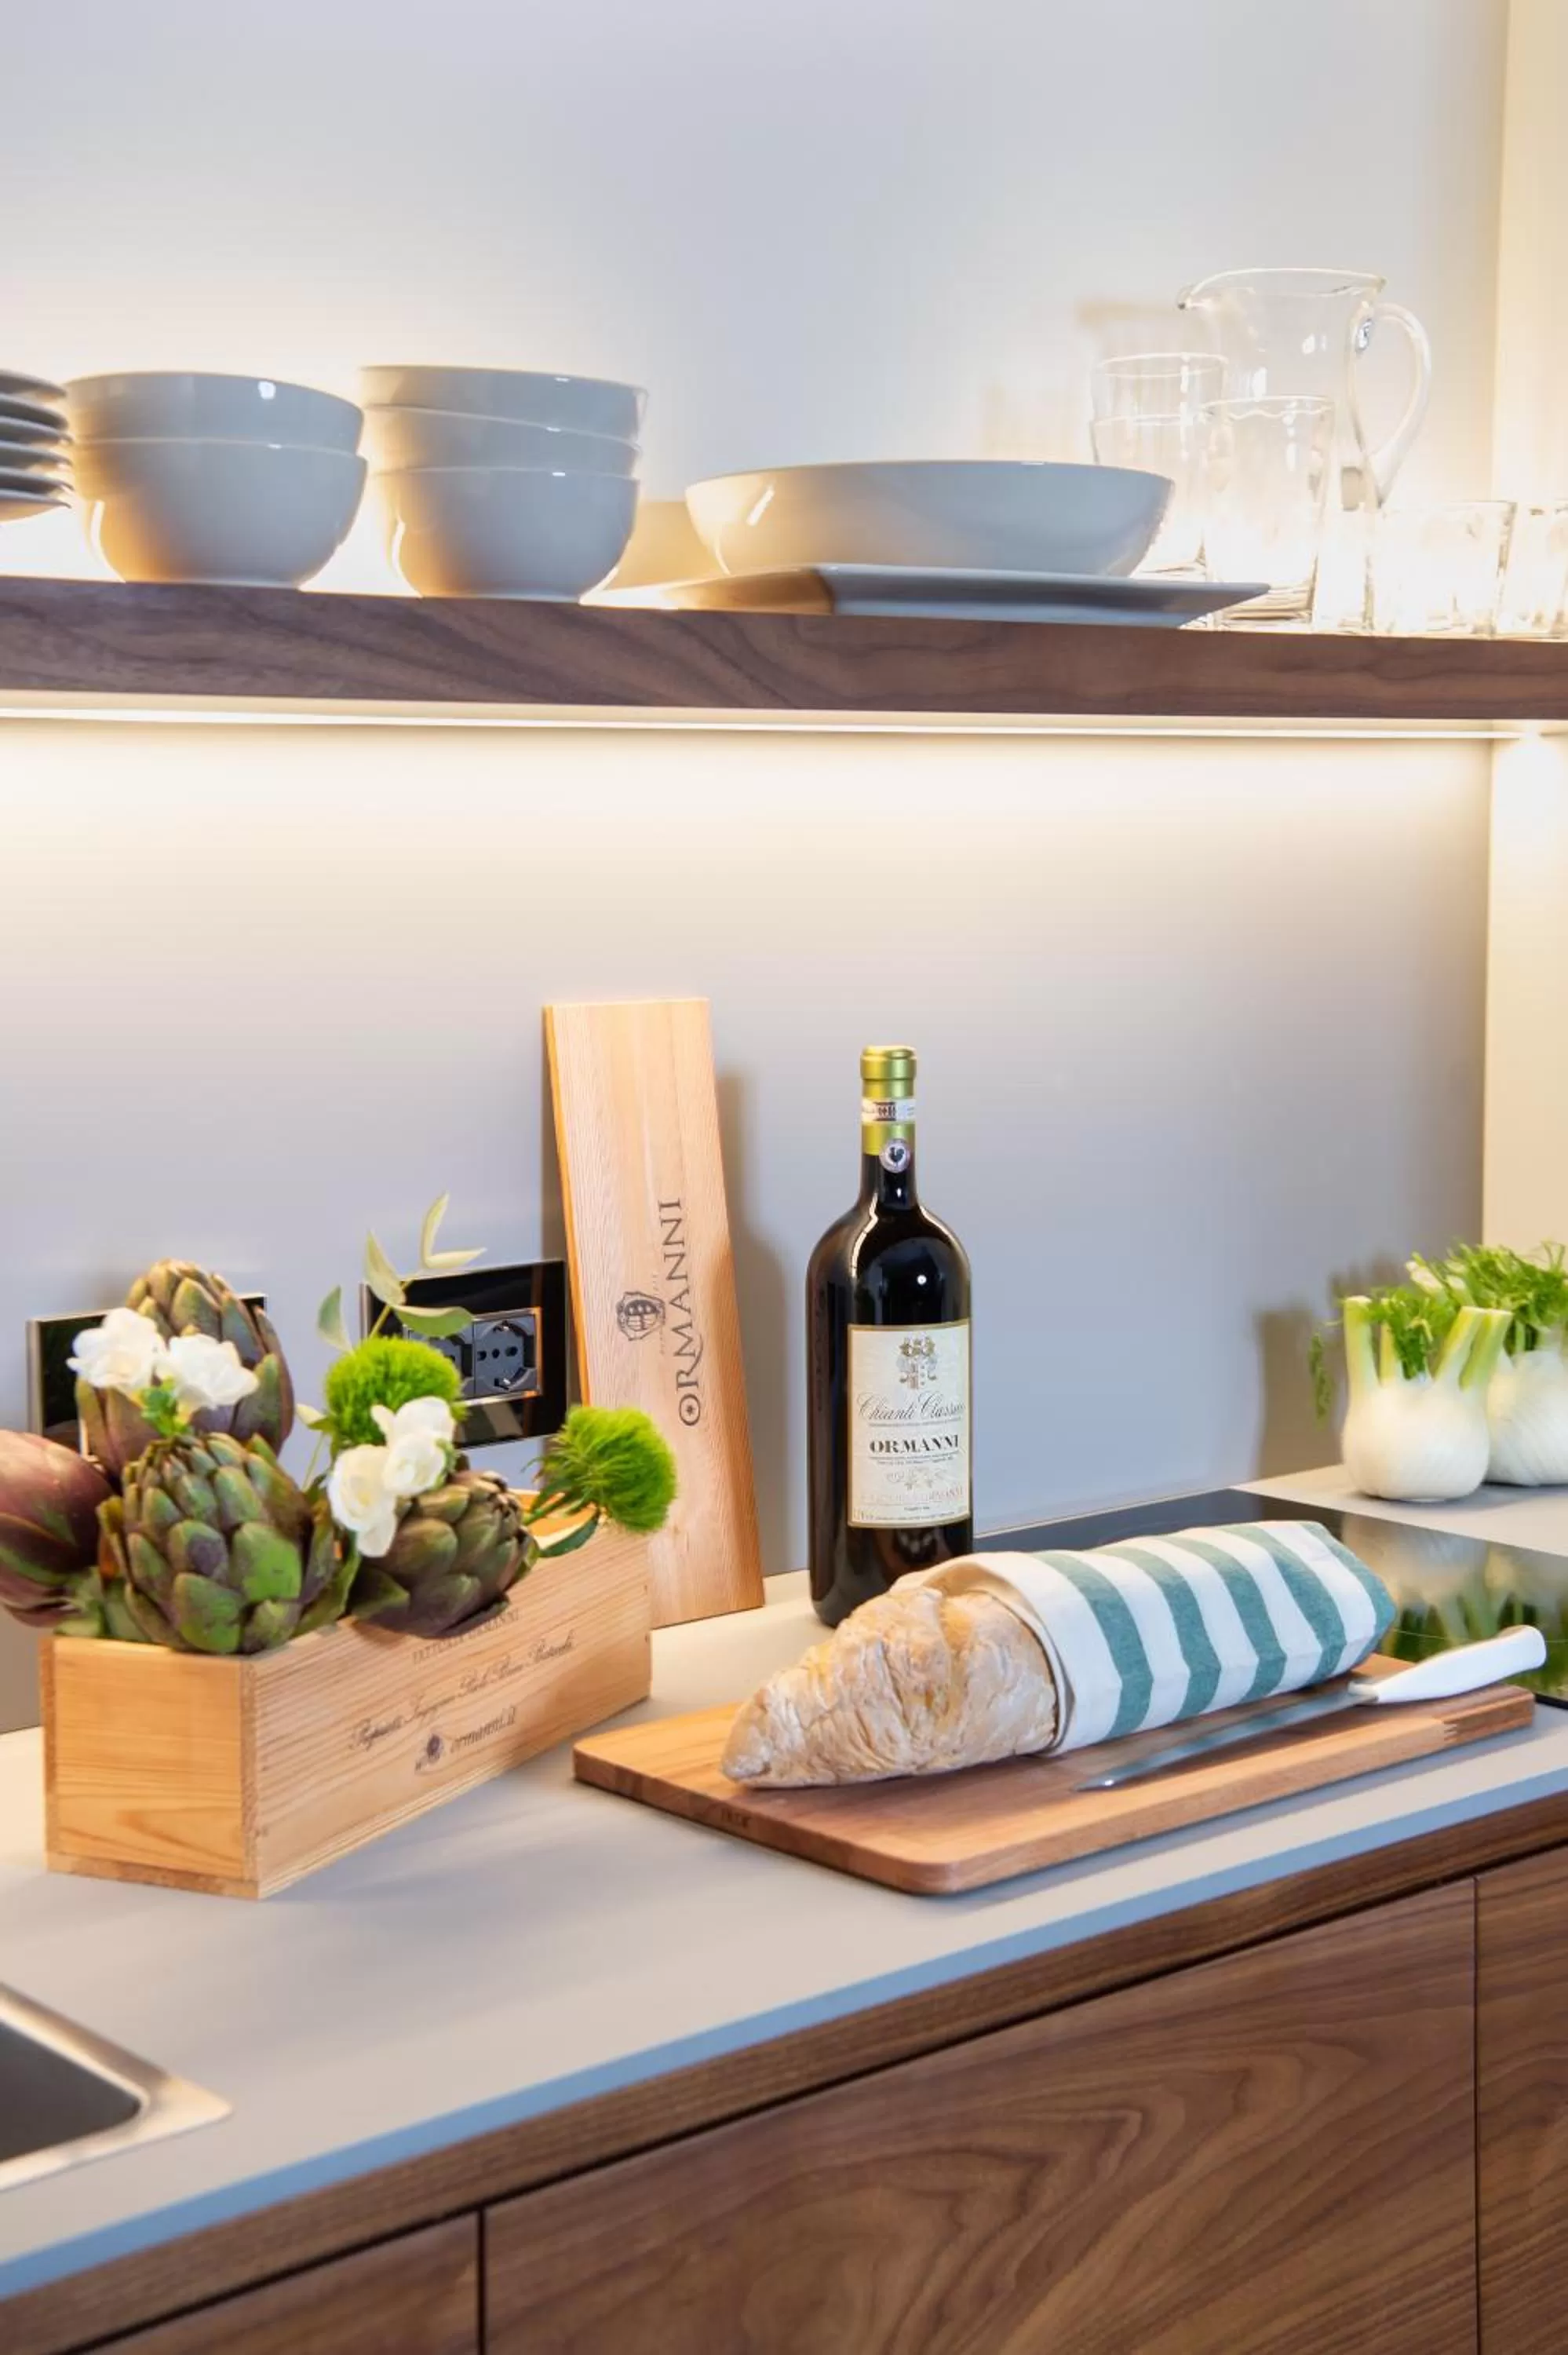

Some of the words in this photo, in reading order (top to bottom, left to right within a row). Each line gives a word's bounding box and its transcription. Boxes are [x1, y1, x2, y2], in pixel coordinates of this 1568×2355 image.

[658, 1198, 703, 1426] ORMANNI
[857, 1393, 914, 1420] Chianti
[869, 1433, 958, 1454] ORMANNI
